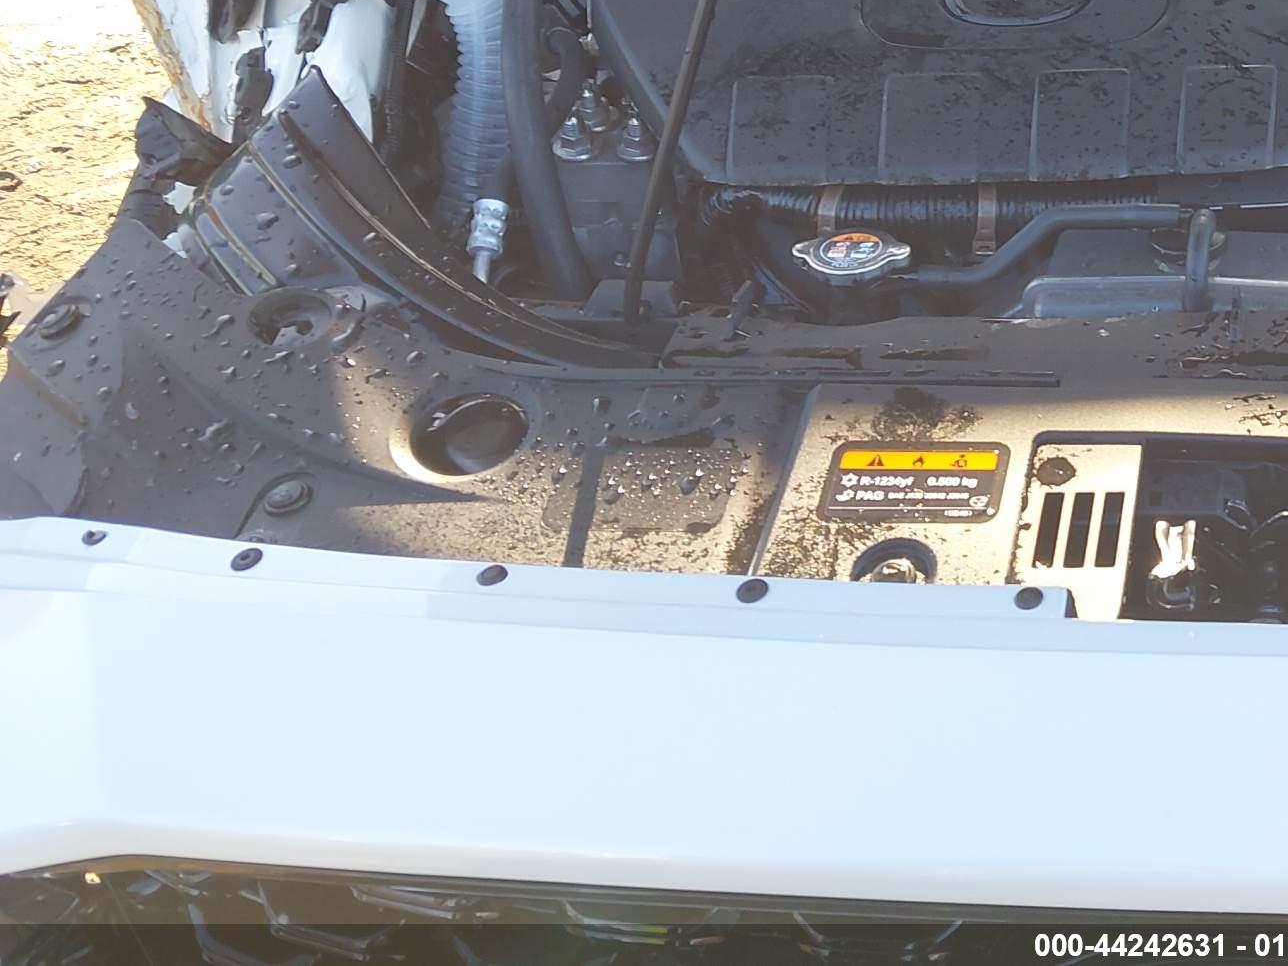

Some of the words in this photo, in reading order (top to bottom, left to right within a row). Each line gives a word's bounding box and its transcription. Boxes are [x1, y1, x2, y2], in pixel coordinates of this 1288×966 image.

[859, 475, 915, 488] R-1234yf
[961, 476, 979, 489] kg
[855, 490, 885, 501] PAG
